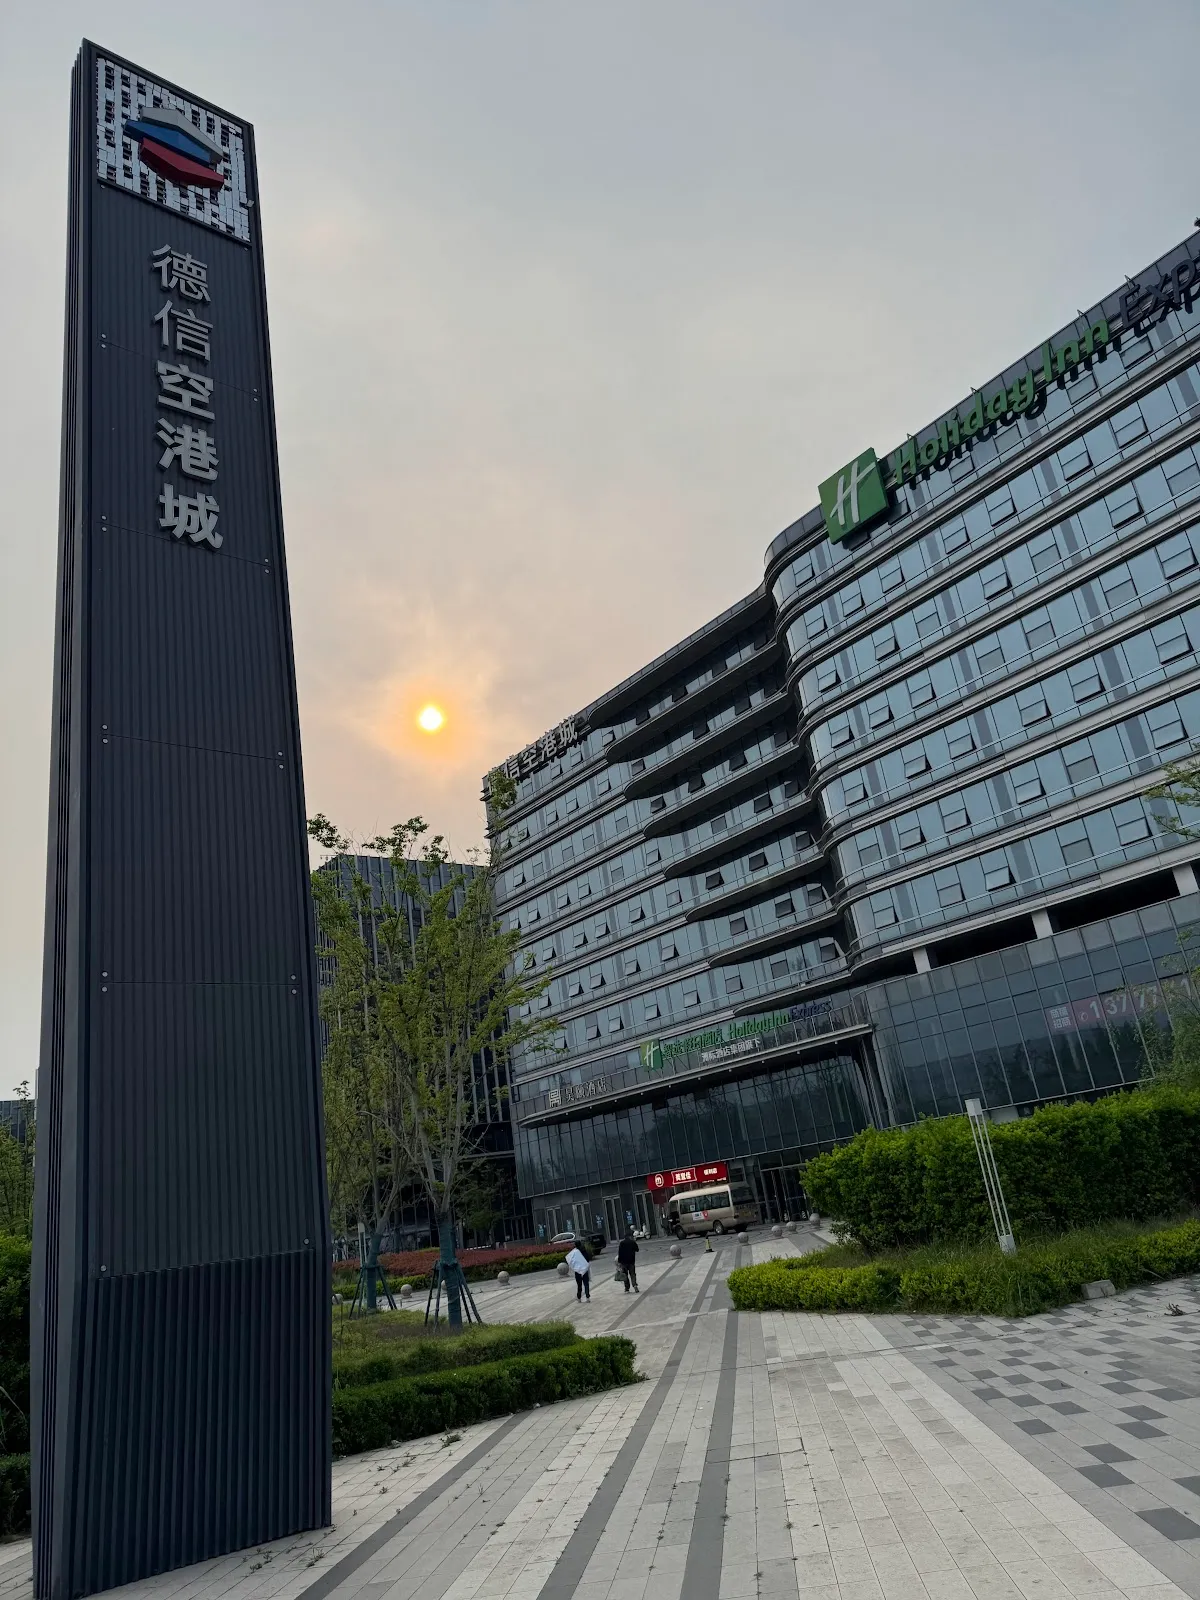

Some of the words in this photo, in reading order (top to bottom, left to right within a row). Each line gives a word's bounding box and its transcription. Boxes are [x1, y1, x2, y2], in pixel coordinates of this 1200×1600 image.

[152, 243, 224, 550] 德信空港城
[893, 369, 1036, 485] Holiday
[1041, 318, 1109, 384] Inn
[487, 718, 578, 797] 信空港城
[728, 1017, 771, 1039] Holiday
[790, 1001, 833, 1020] Express
